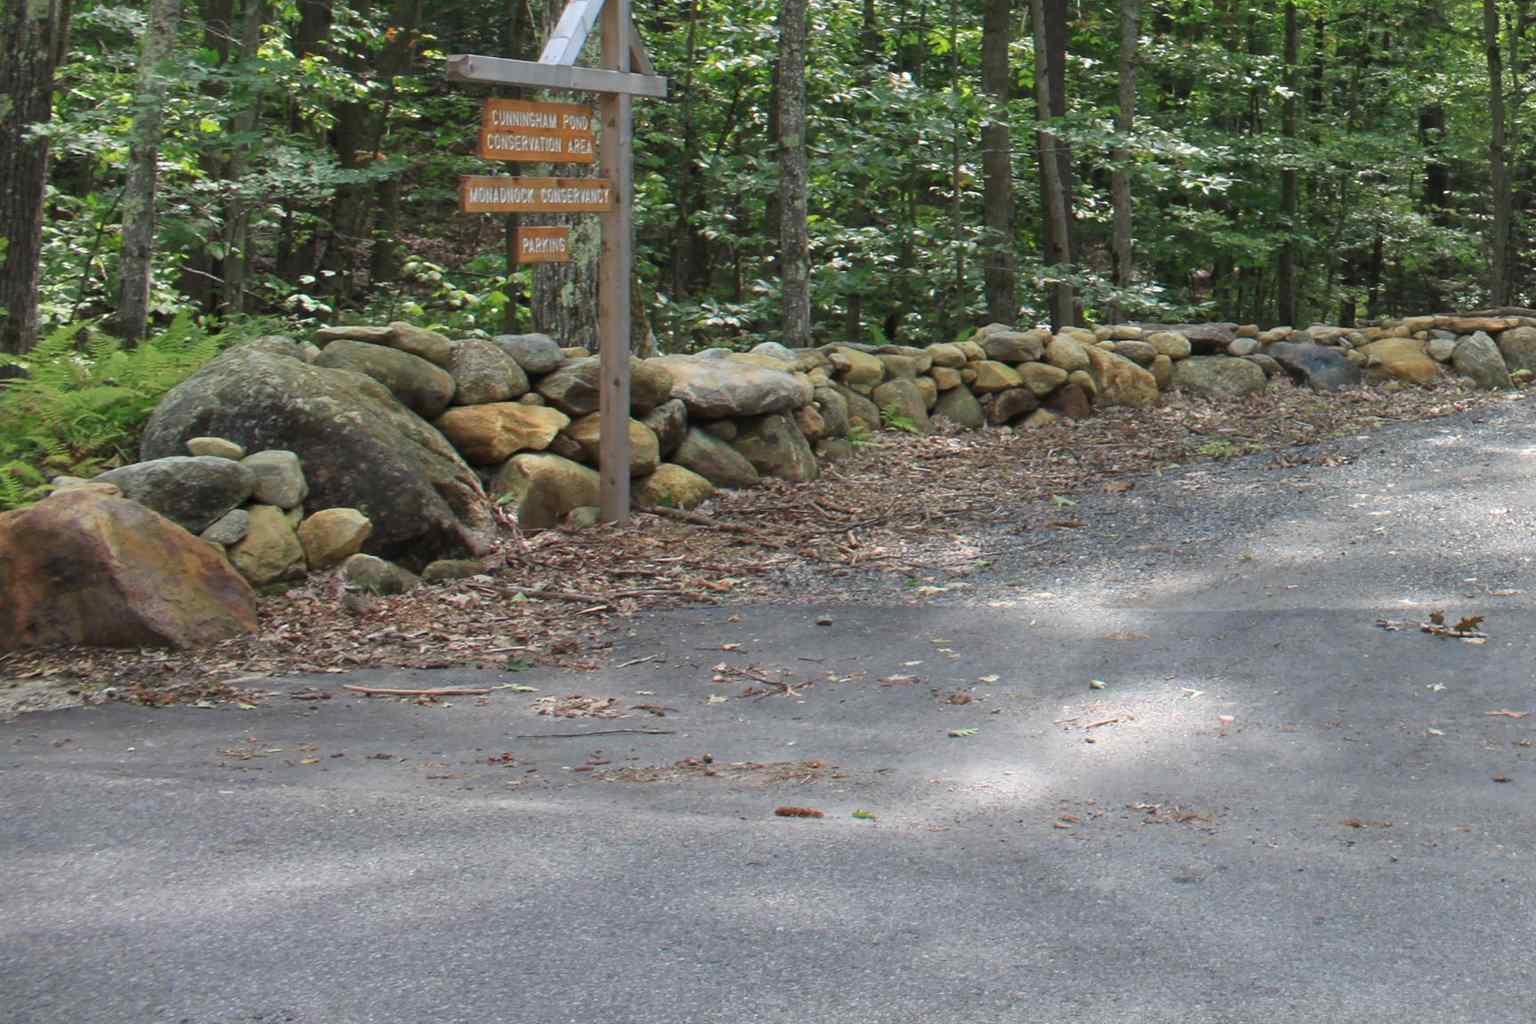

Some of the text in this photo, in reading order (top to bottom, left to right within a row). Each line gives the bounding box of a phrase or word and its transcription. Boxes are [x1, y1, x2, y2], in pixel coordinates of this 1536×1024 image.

[492, 110, 589, 130] CUNNINGHAM POND
[487, 134, 592, 154] CONSERVATION AREA
[470, 187, 609, 204] MONADNOCK CONSERVANCY
[522, 237, 566, 253] PARKING
